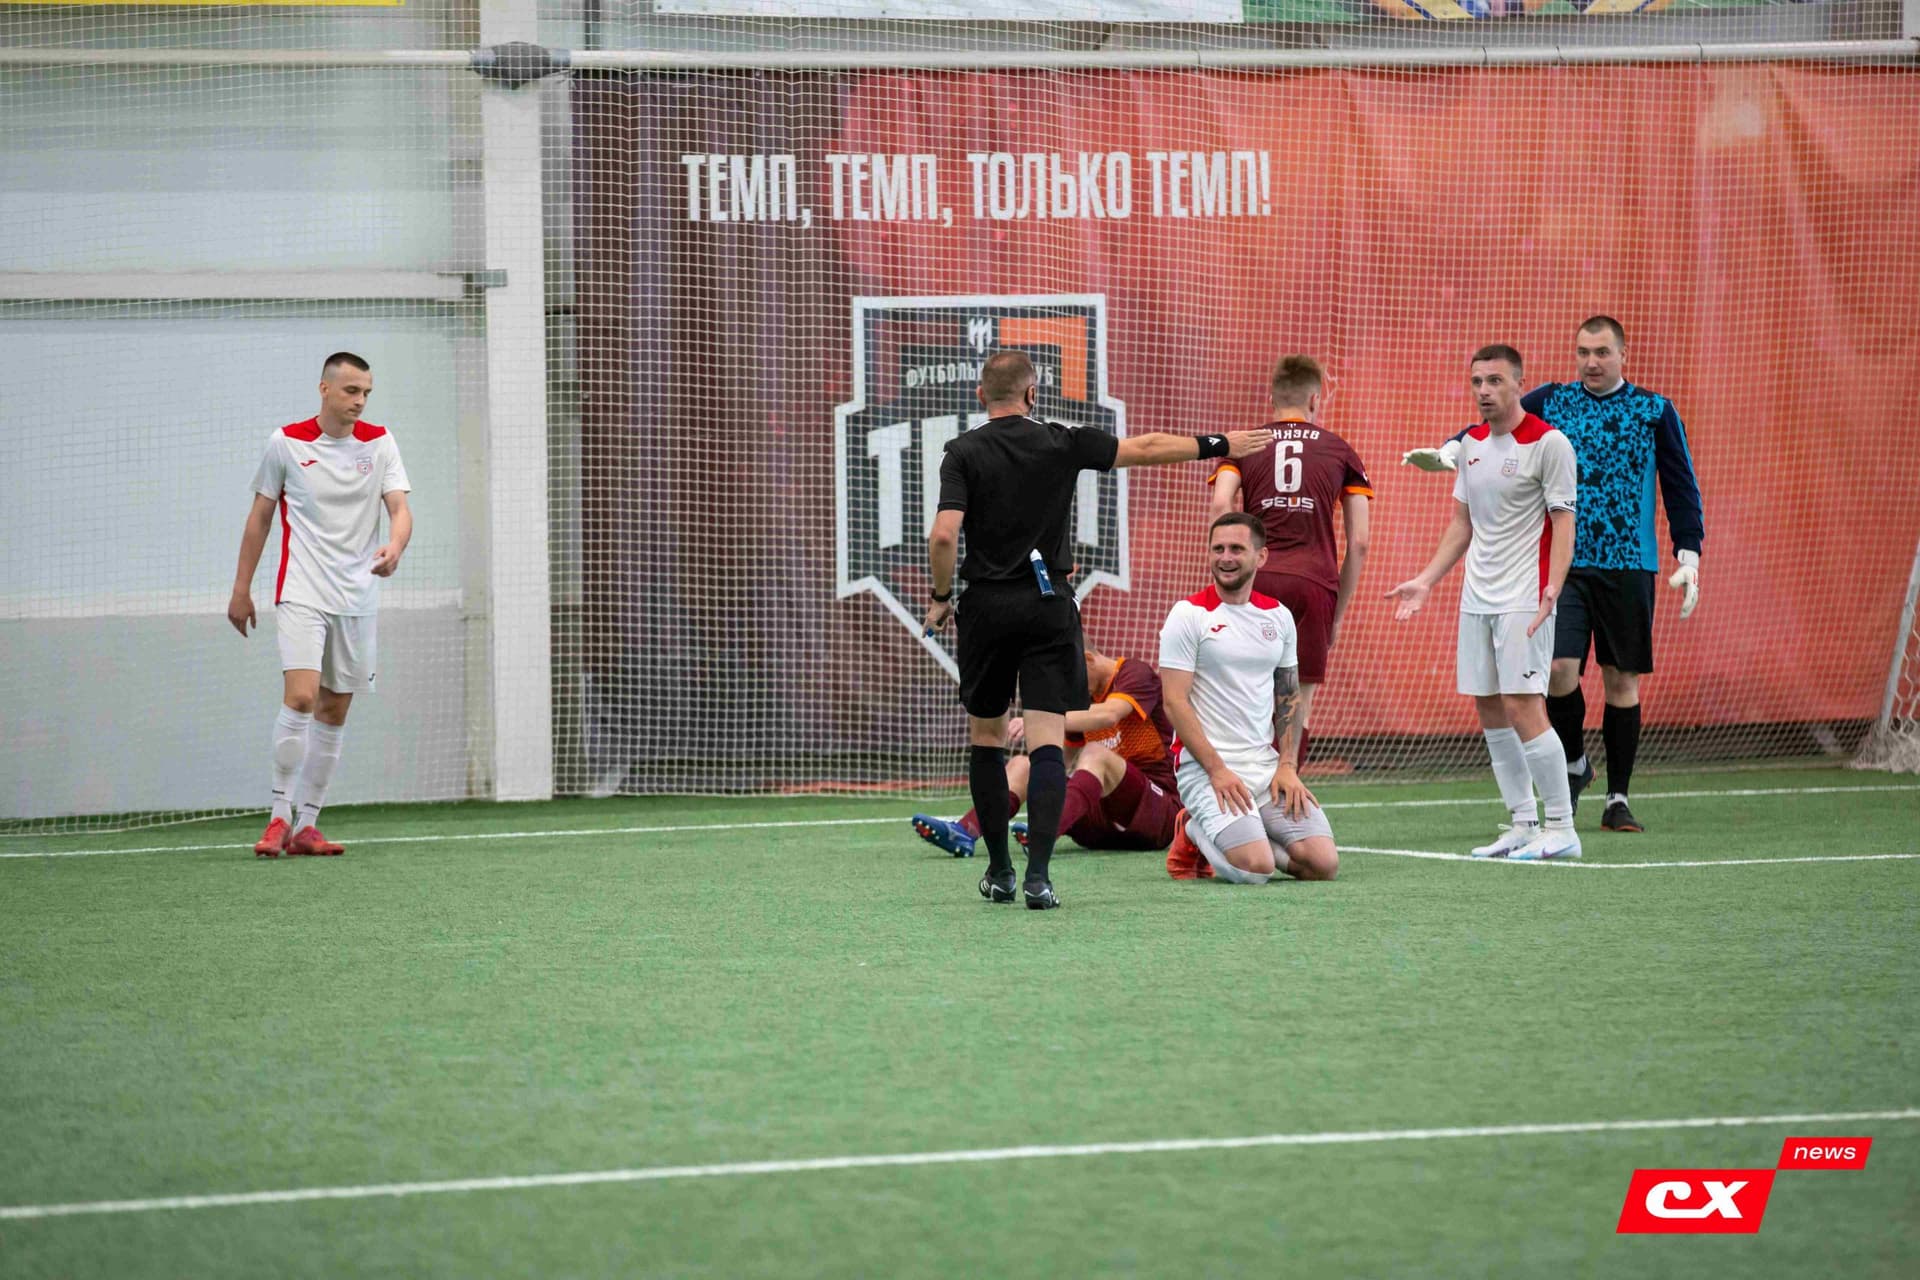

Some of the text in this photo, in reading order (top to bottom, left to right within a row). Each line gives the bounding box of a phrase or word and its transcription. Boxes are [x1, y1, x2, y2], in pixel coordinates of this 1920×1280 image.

[682, 151, 1271, 229] ТЕМП, ТЕМП, ТОЛЬКО ТЕМП!
[906, 361, 984, 388] ФУТБОЛЬН
[1275, 440, 1304, 493] 6
